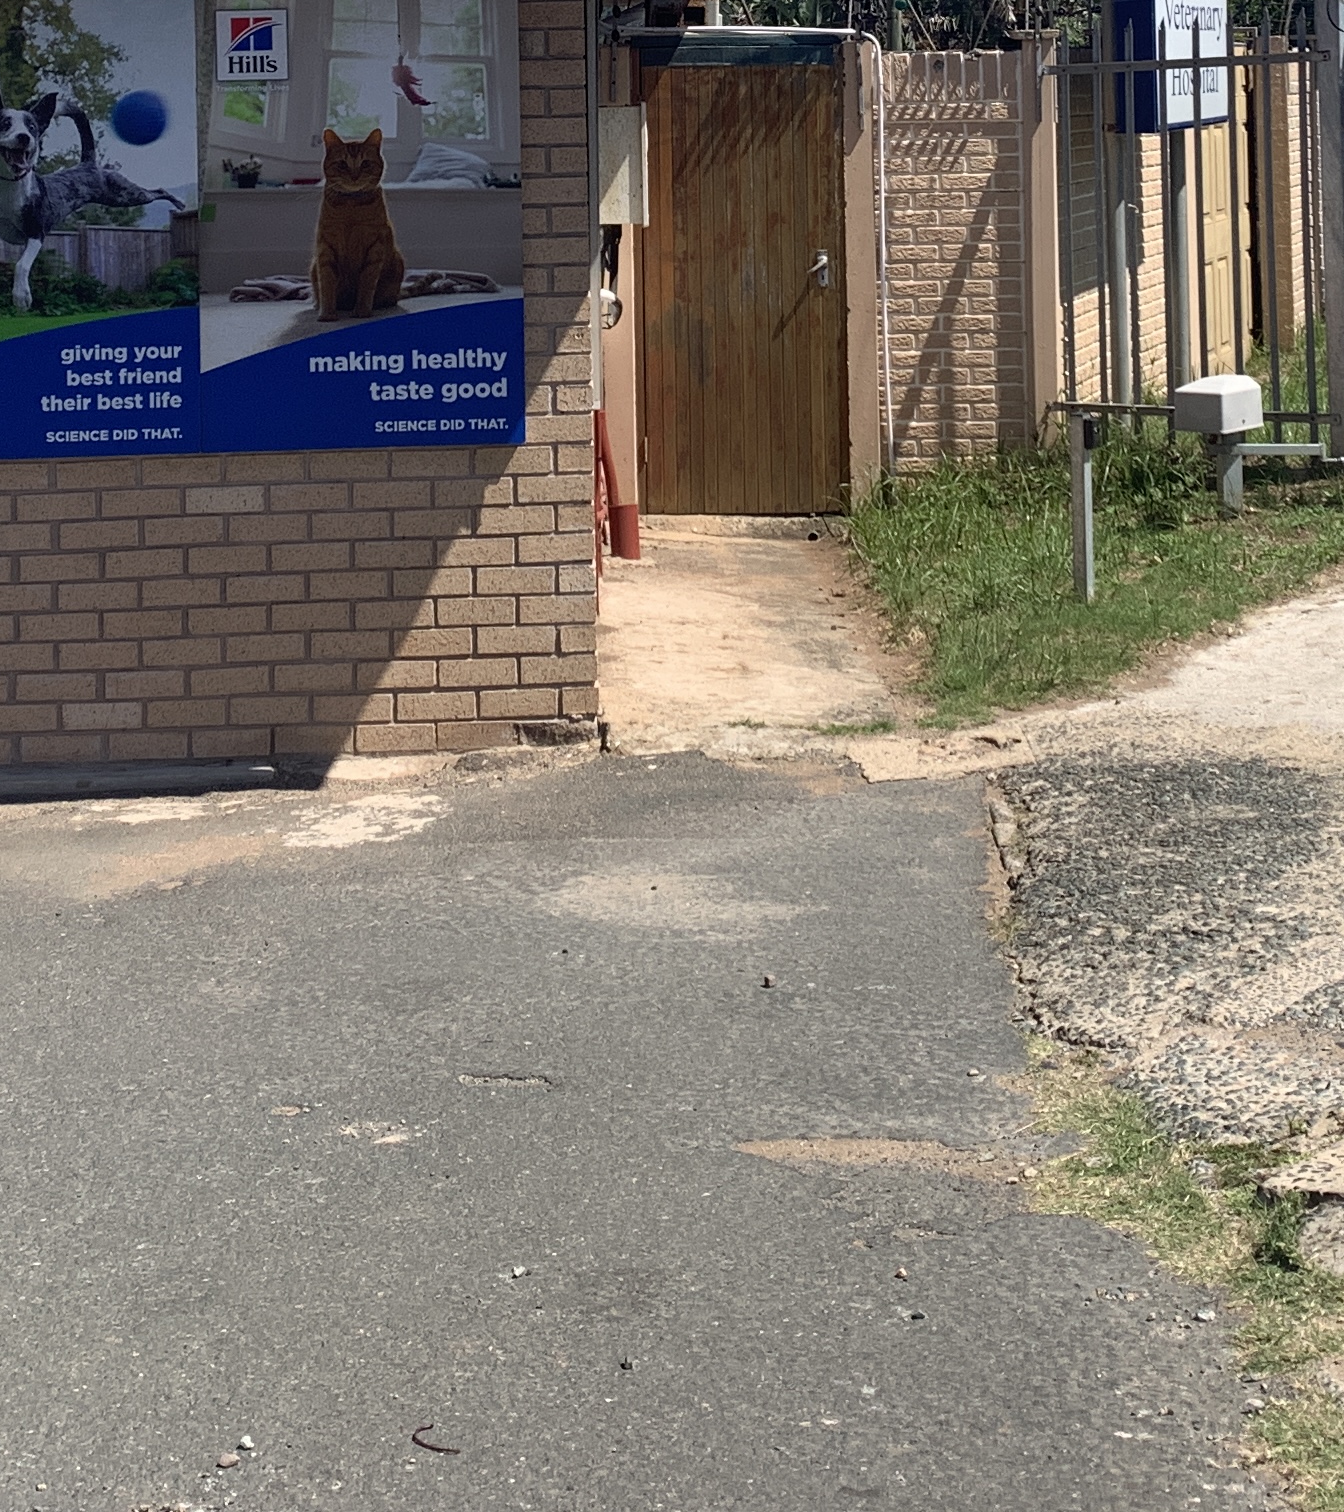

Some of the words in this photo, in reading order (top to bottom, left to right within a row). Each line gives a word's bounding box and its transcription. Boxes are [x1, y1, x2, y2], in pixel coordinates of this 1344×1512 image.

[227, 54, 278, 75] Hill's
[1171, 66, 1219, 96] Hosital
[60, 344, 128, 365] giving
[133, 345, 183, 363] your
[309, 351, 404, 374] making
[411, 347, 507, 371] healthy
[66, 369, 113, 386] best
[118, 366, 182, 385] friend
[369, 381, 434, 401] taste
[441, 377, 507, 403] good
[40, 393, 92, 412] their
[97, 393, 143, 410] best
[149, 391, 182, 408] life
[45, 430, 109, 443] SCIENCE
[112, 429, 138, 440] DID
[142, 427, 183, 439] THAT.
[375, 419, 436, 432] SCIENCE
[440, 418, 465, 431] DID
[468, 418, 509, 430] THAT.
